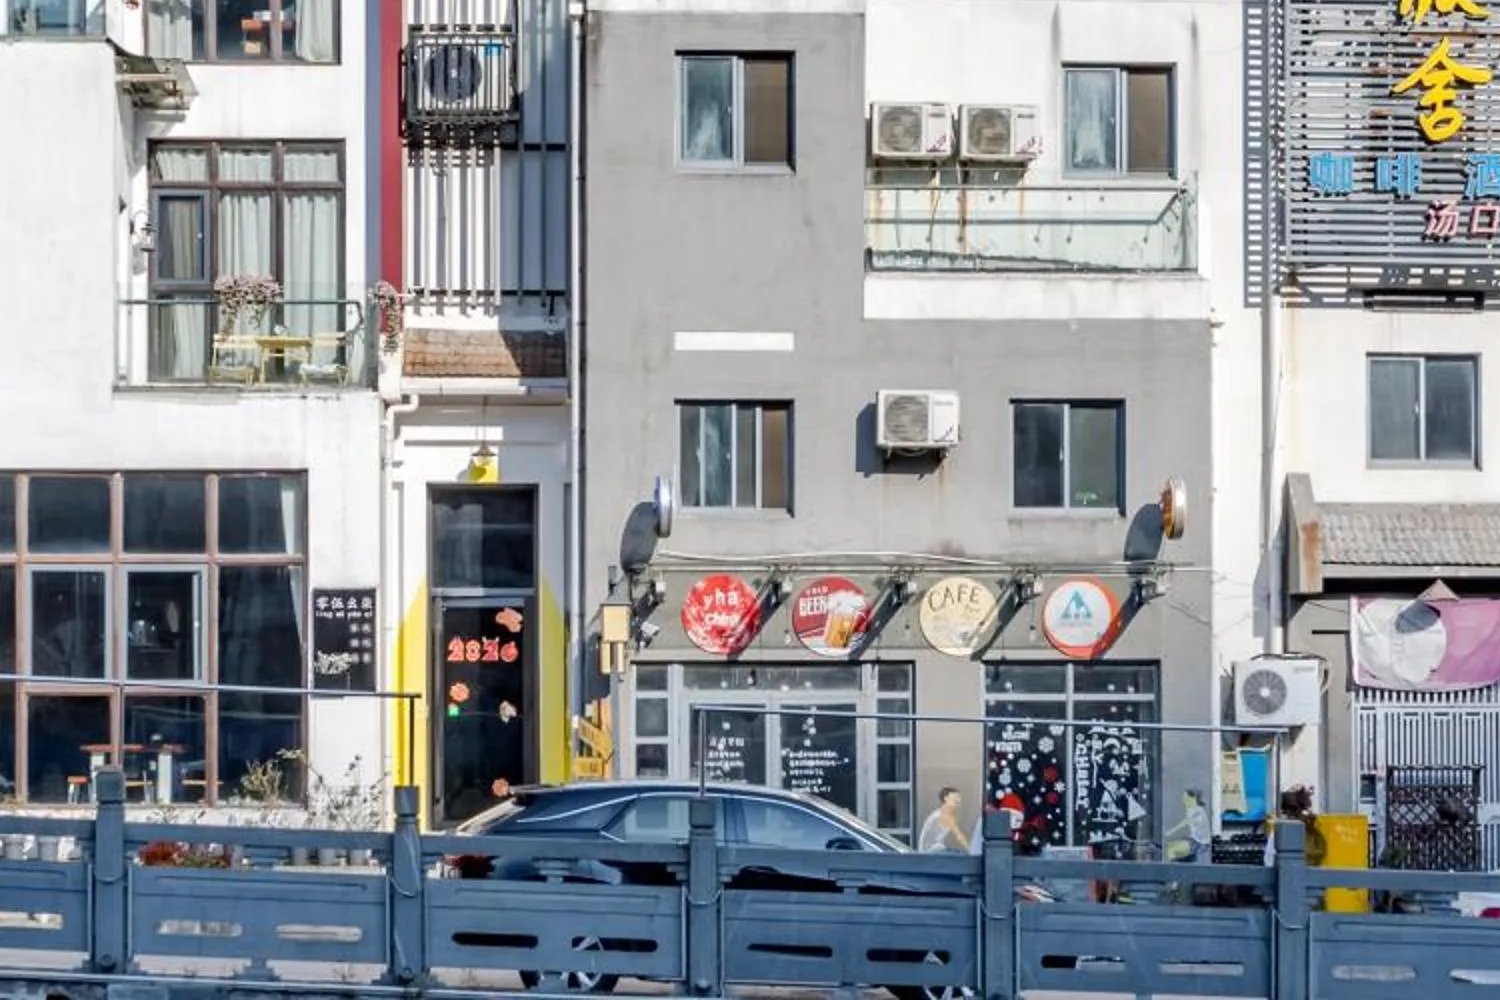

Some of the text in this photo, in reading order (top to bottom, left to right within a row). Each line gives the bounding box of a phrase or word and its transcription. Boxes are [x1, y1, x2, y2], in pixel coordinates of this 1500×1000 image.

[1309, 151, 1422, 197] 咖啡
[703, 589, 738, 610] yha
[928, 583, 981, 613] CAFE
